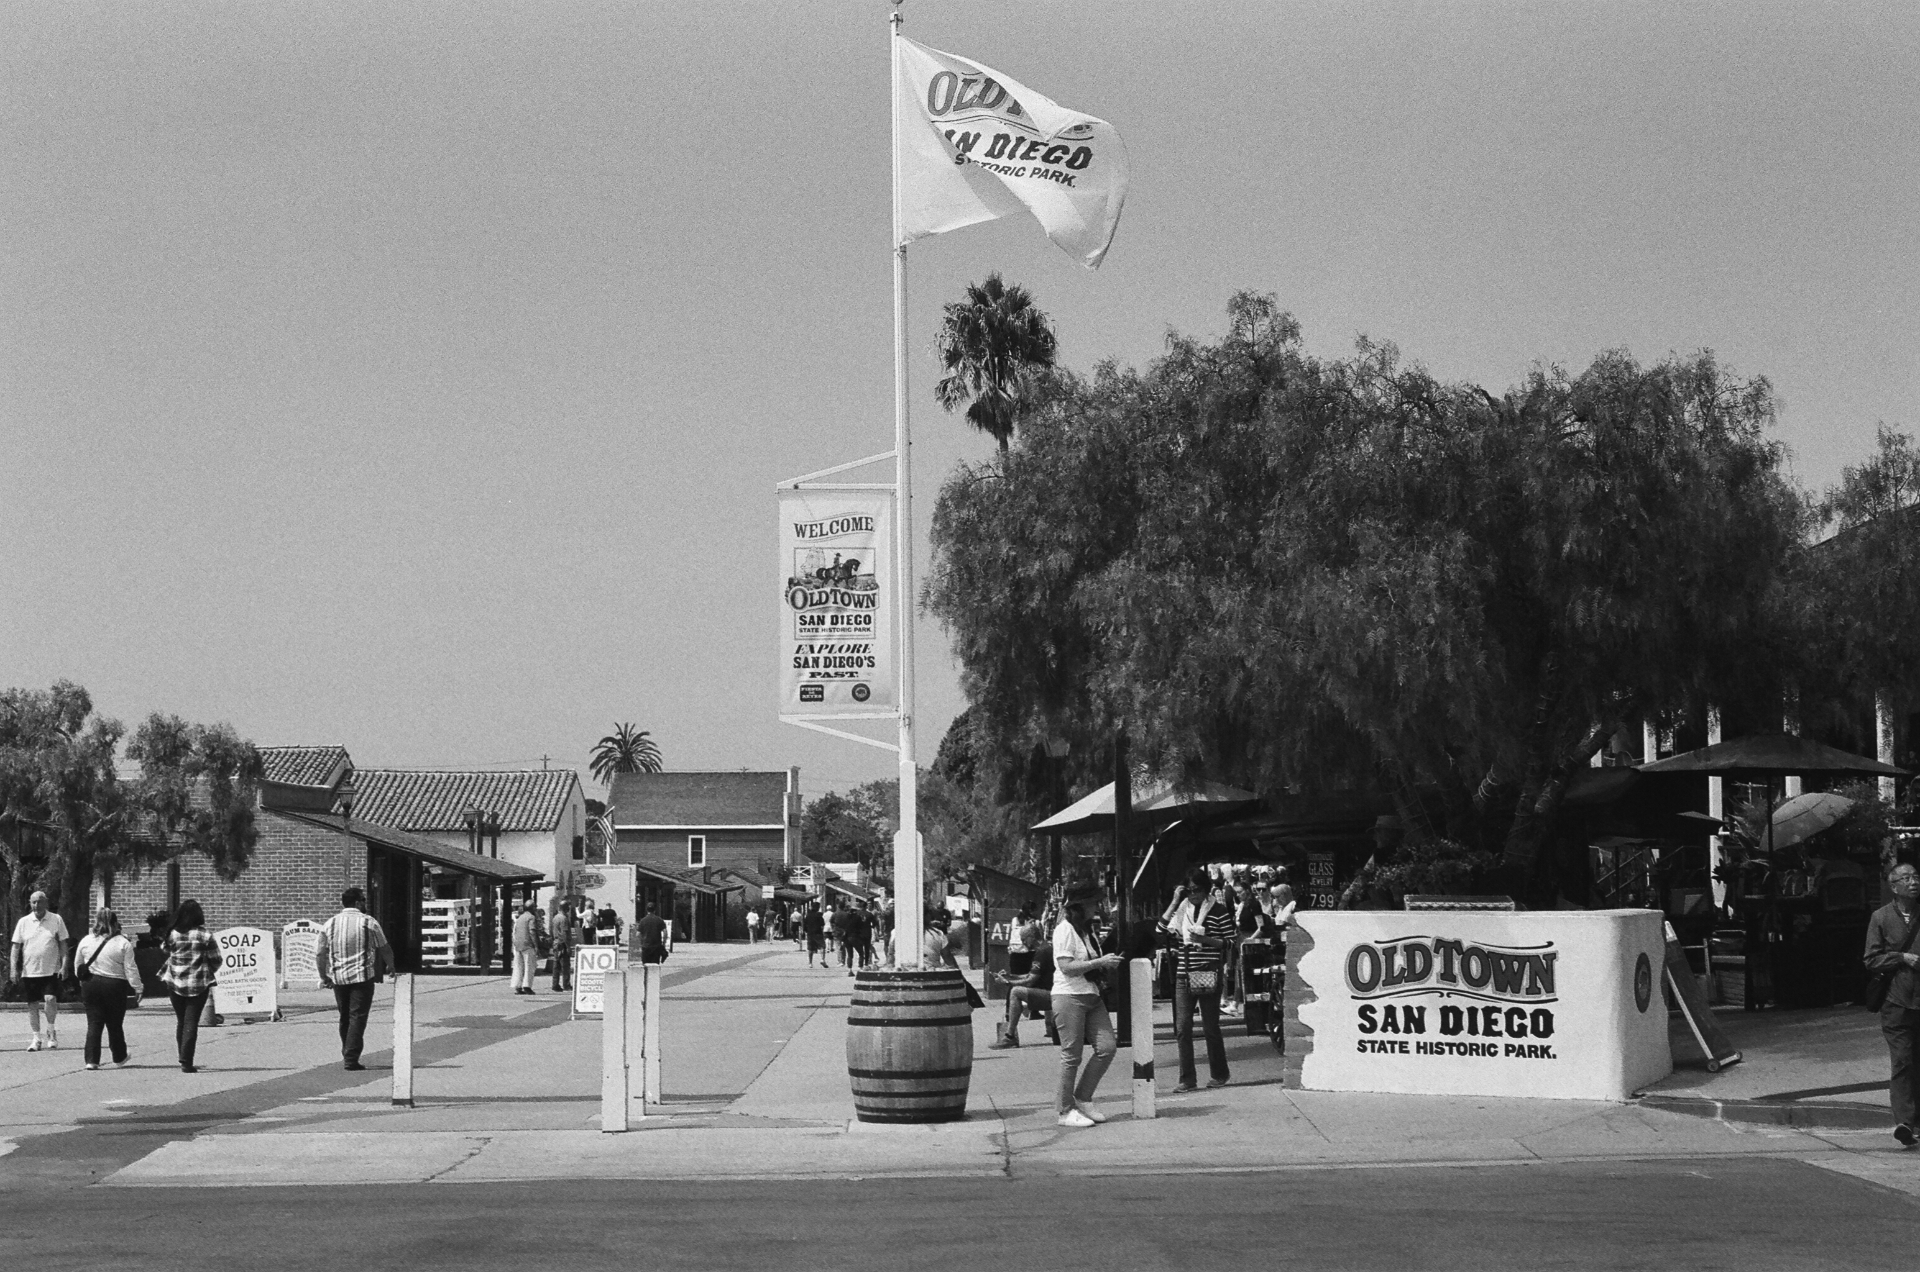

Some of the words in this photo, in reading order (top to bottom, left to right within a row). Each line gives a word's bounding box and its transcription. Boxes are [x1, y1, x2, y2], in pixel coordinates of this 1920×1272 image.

[984, 133, 1093, 170] DIEGO
[1029, 167, 1077, 188] PARK.
[794, 516, 874, 539] WELCOME
[799, 614, 825, 626] SAN
[830, 614, 872, 626] DIEGO
[794, 643, 874, 654] EXPLORE
[793, 656, 820, 668] SAN
[823, 656, 876, 669] DIEGO'S
[1308, 862, 1334, 875] GLASS
[1310, 877, 1333, 886] JEWELRY
[1310, 893, 1334, 908] 7.99
[285, 928, 301, 936] GUM
[220, 934, 261, 949] SOAP
[225, 953, 257, 968] OILS
[580, 953, 613, 970] NO
[1357, 1003, 1427, 1035] SAN
[1439, 1005, 1555, 1039] DIEGO
[1356, 1039, 1410, 1054] STATE
[1416, 1041, 1499, 1057] HISTORIC
[1504, 1042, 1557, 1060] PARK.
